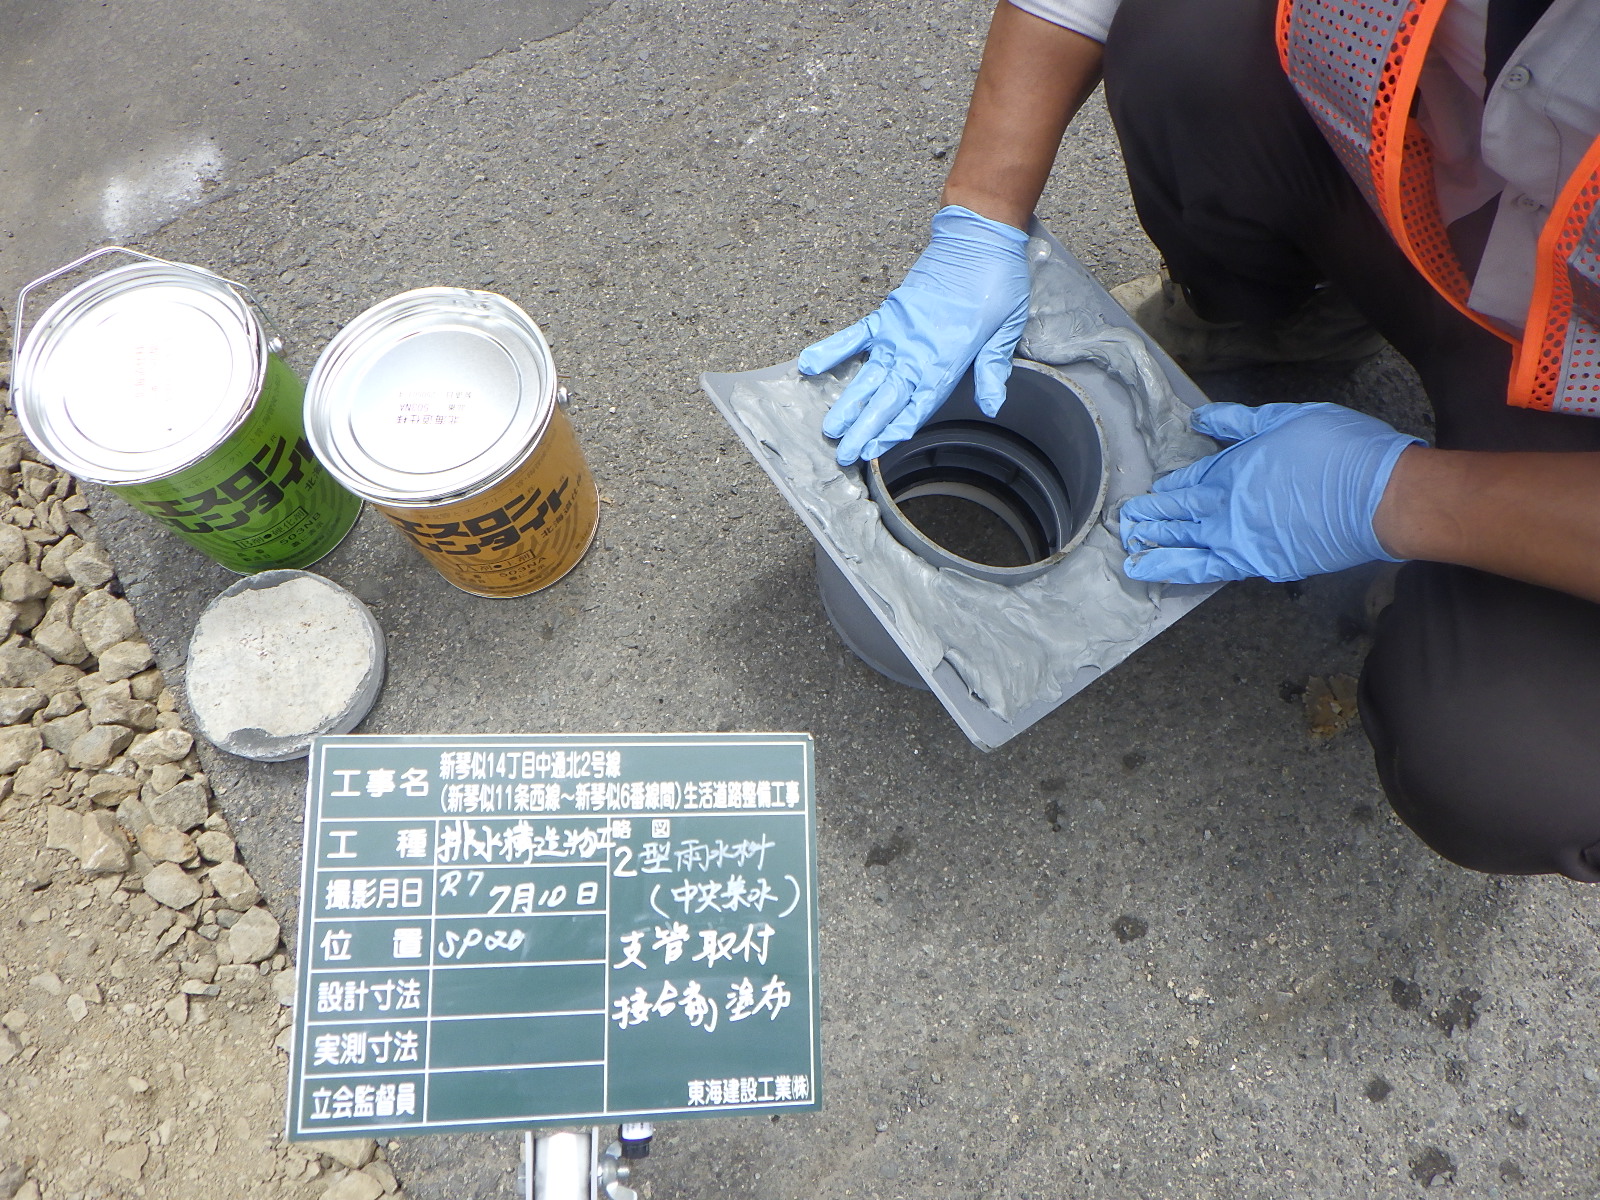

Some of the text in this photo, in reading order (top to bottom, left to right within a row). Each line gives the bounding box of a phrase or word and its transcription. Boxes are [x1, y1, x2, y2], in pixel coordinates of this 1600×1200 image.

[140, 436, 286, 517] エスロン
[386, 488, 542, 538] エスロン
[330, 766, 430, 798] 工事名
[438, 750, 622, 781] 新琴似14丁目中通北2号線
[325, 877, 423, 910] 撮影月日
[612, 921, 776, 970] 支管取付
[316, 977, 421, 1013] 設計寸法
[313, 1029, 419, 1067] 実測寸法
[309, 1082, 416, 1121] 立会監督員
